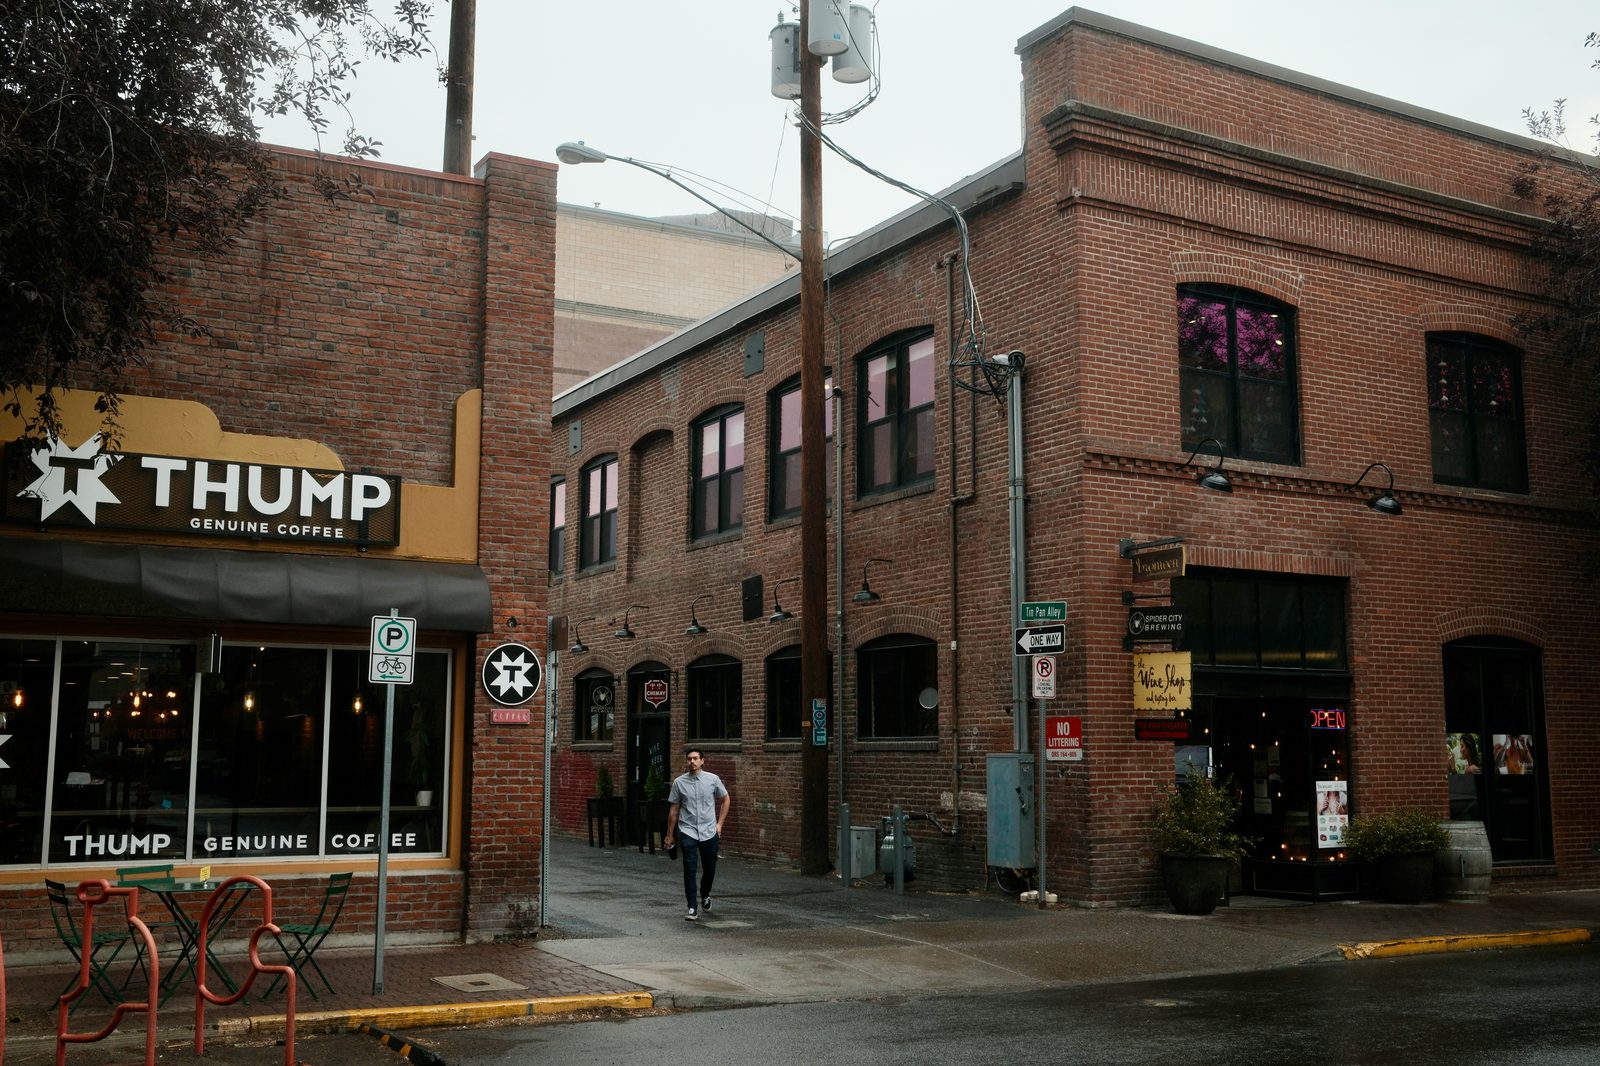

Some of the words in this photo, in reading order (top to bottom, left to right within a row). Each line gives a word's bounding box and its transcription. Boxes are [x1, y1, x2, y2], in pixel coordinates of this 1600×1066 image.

[141, 456, 392, 521] THUMP
[190, 518, 268, 534] GENUINE
[277, 523, 344, 539] COFFEE
[1026, 606, 1034, 617] Tin
[1035, 606, 1046, 617] Pan
[1047, 606, 1062, 620] Alley
[1145, 614, 1167, 623] SPIDER
[1168, 614, 1183, 622] CITY
[1144, 623, 1182, 631] BREWING
[386, 627, 403, 647] P
[1030, 635, 1044, 647] ONE
[1045, 633, 1060, 645] WAY
[1138, 666, 1164, 689] Wine
[1163, 663, 1185, 695] Shop
[1056, 721, 1070, 736] NO
[1048, 737, 1080, 748] LITTERING
[64, 833, 171, 856] THUMP
[203, 834, 308, 852] GENUINE
[331, 832, 417, 849] COFEE
